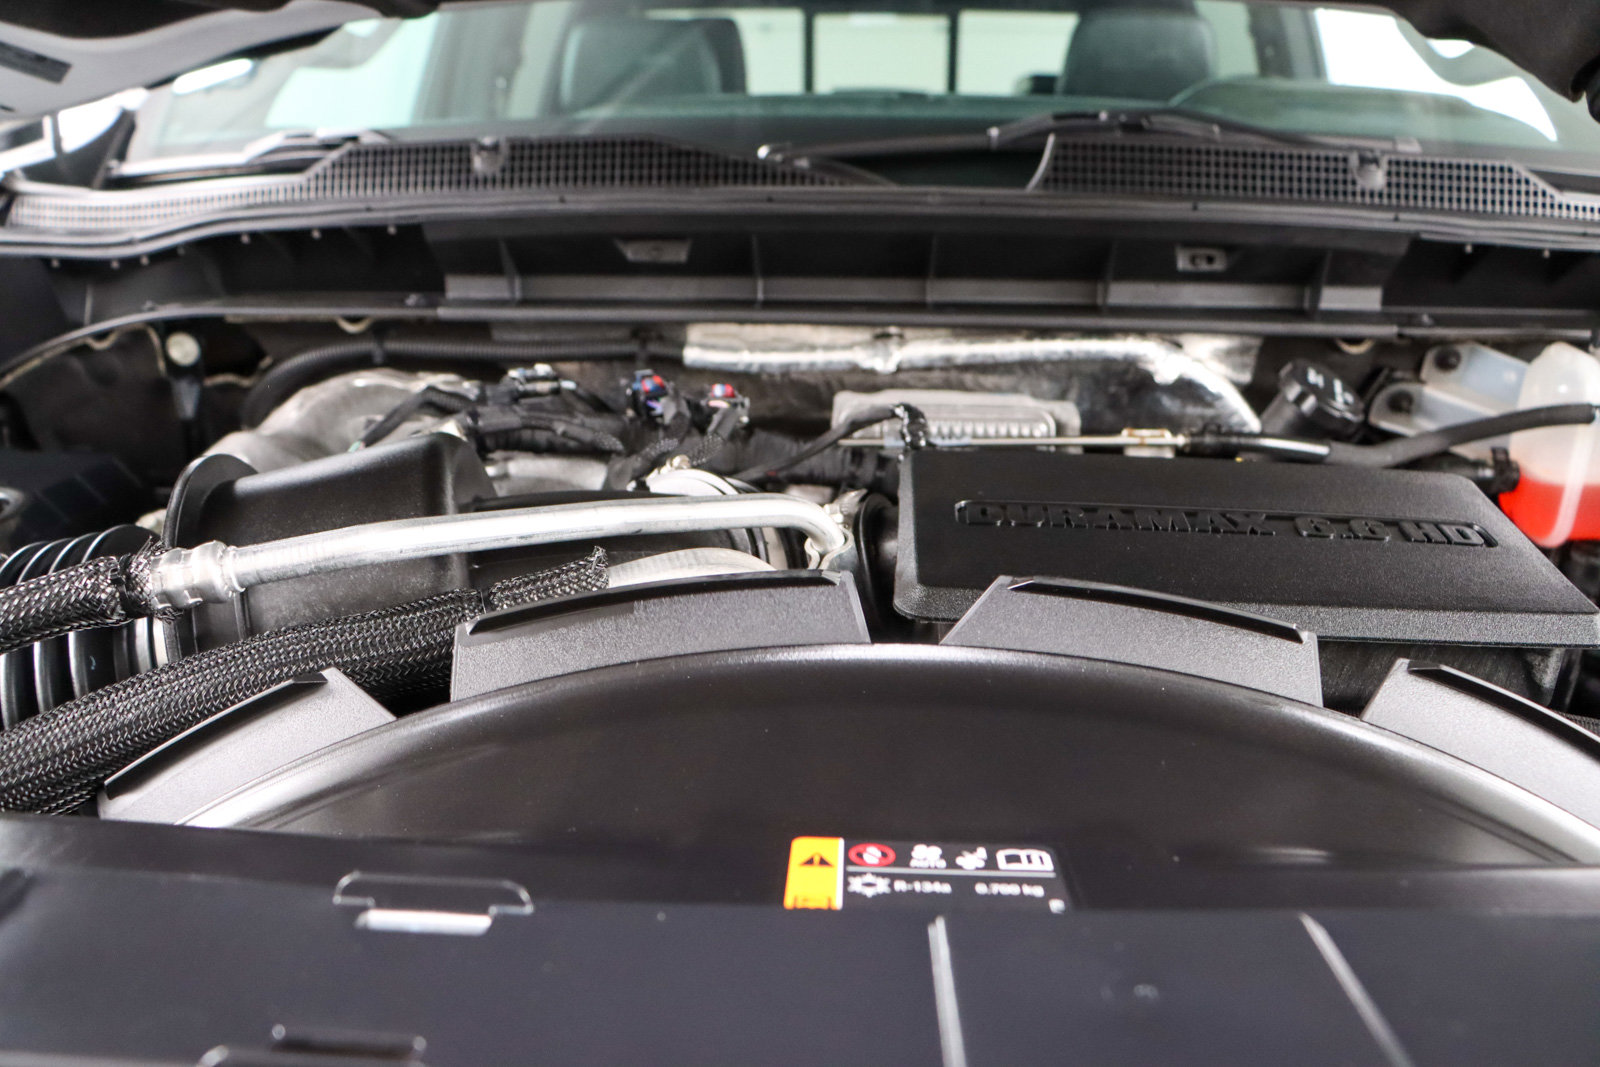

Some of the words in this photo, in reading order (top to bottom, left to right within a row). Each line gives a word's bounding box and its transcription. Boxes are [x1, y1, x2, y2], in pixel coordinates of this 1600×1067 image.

[966, 502, 1276, 536] DURAMAX
[1294, 516, 1392, 542] 6.6
[1401, 521, 1485, 547] HD
